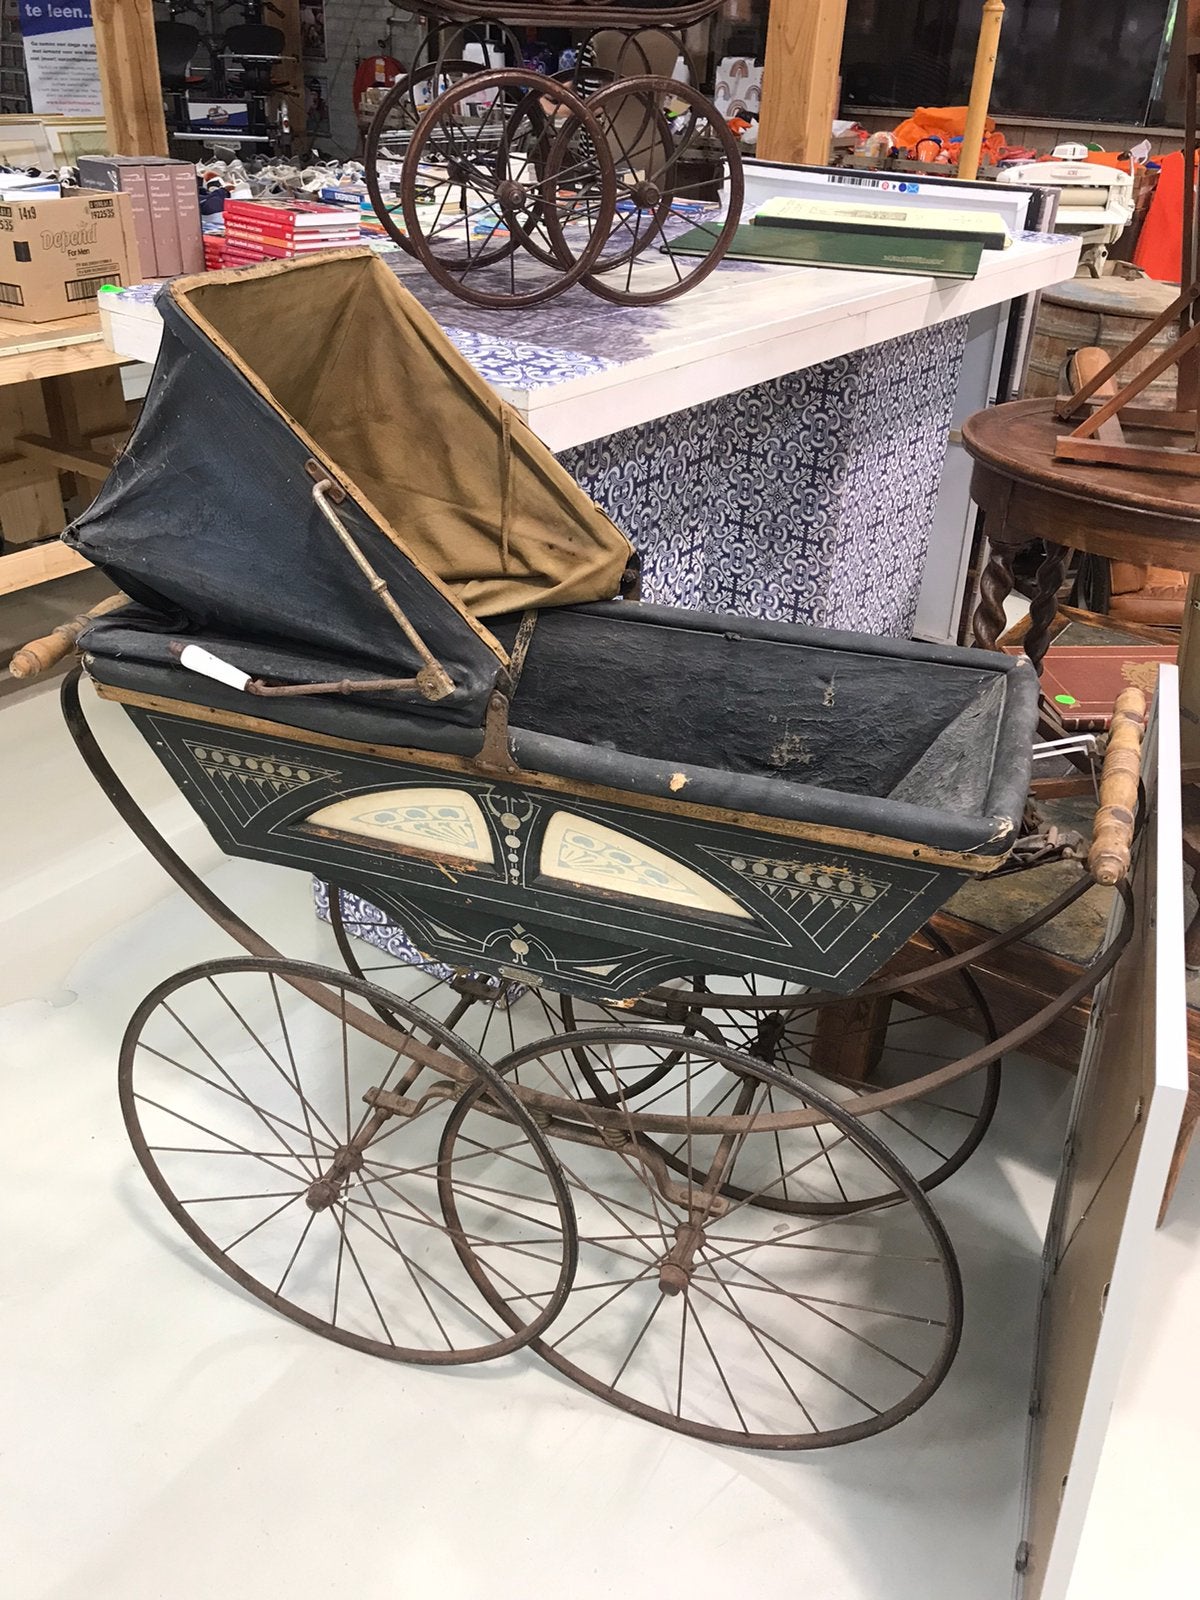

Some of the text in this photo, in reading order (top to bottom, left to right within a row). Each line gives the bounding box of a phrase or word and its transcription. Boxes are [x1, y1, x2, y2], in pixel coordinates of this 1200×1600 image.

[25, 4, 42, 17] te
[18, 206, 37, 220] 14x9
[40, 222, 98, 253] Depend
